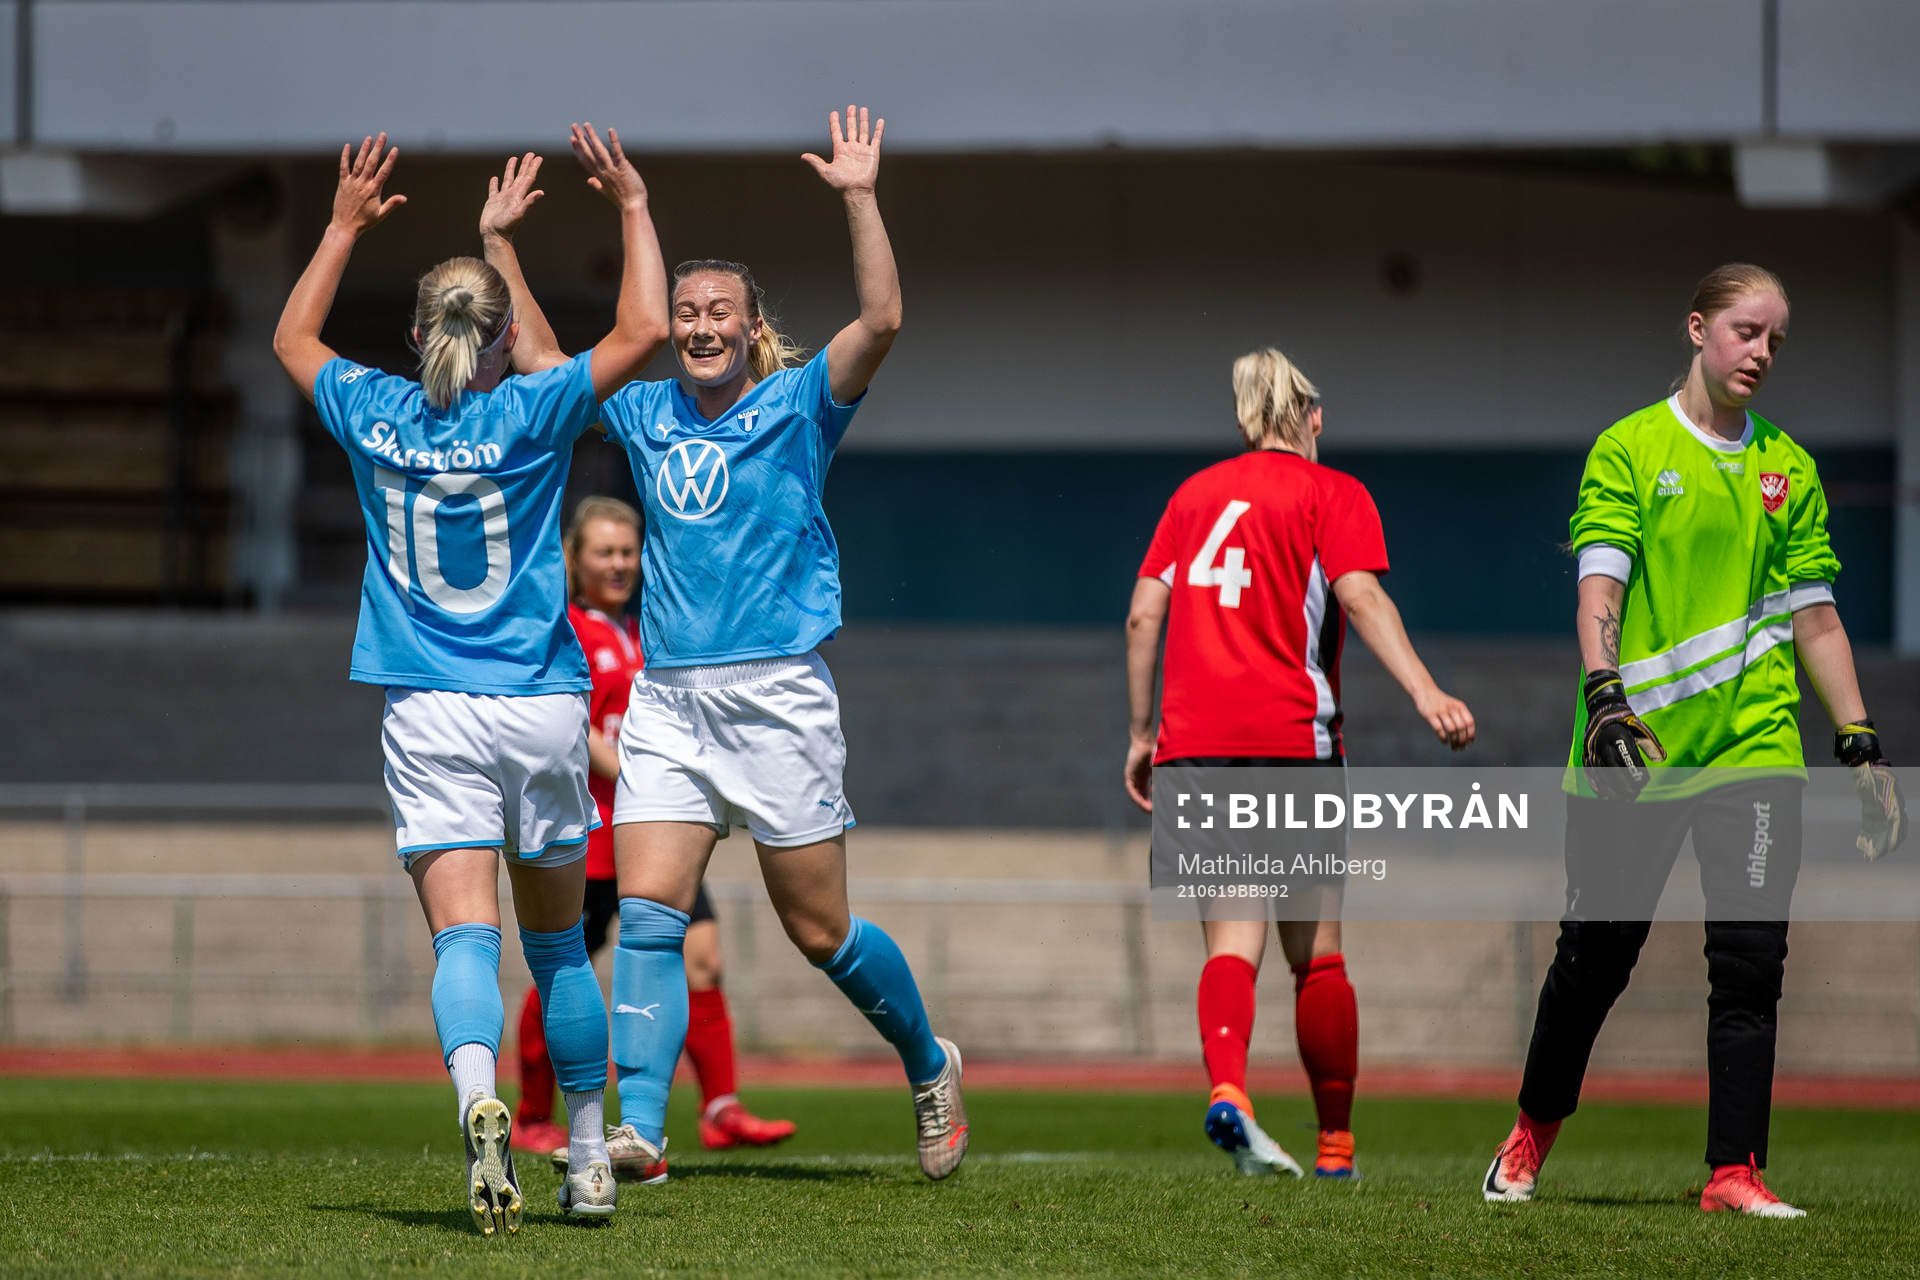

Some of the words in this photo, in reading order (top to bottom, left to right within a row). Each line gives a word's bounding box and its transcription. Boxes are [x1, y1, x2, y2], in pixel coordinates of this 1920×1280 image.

[374, 465, 512, 614] 10
[1188, 500, 1252, 608] 4
[1747, 801, 1772, 888] uhlsport
